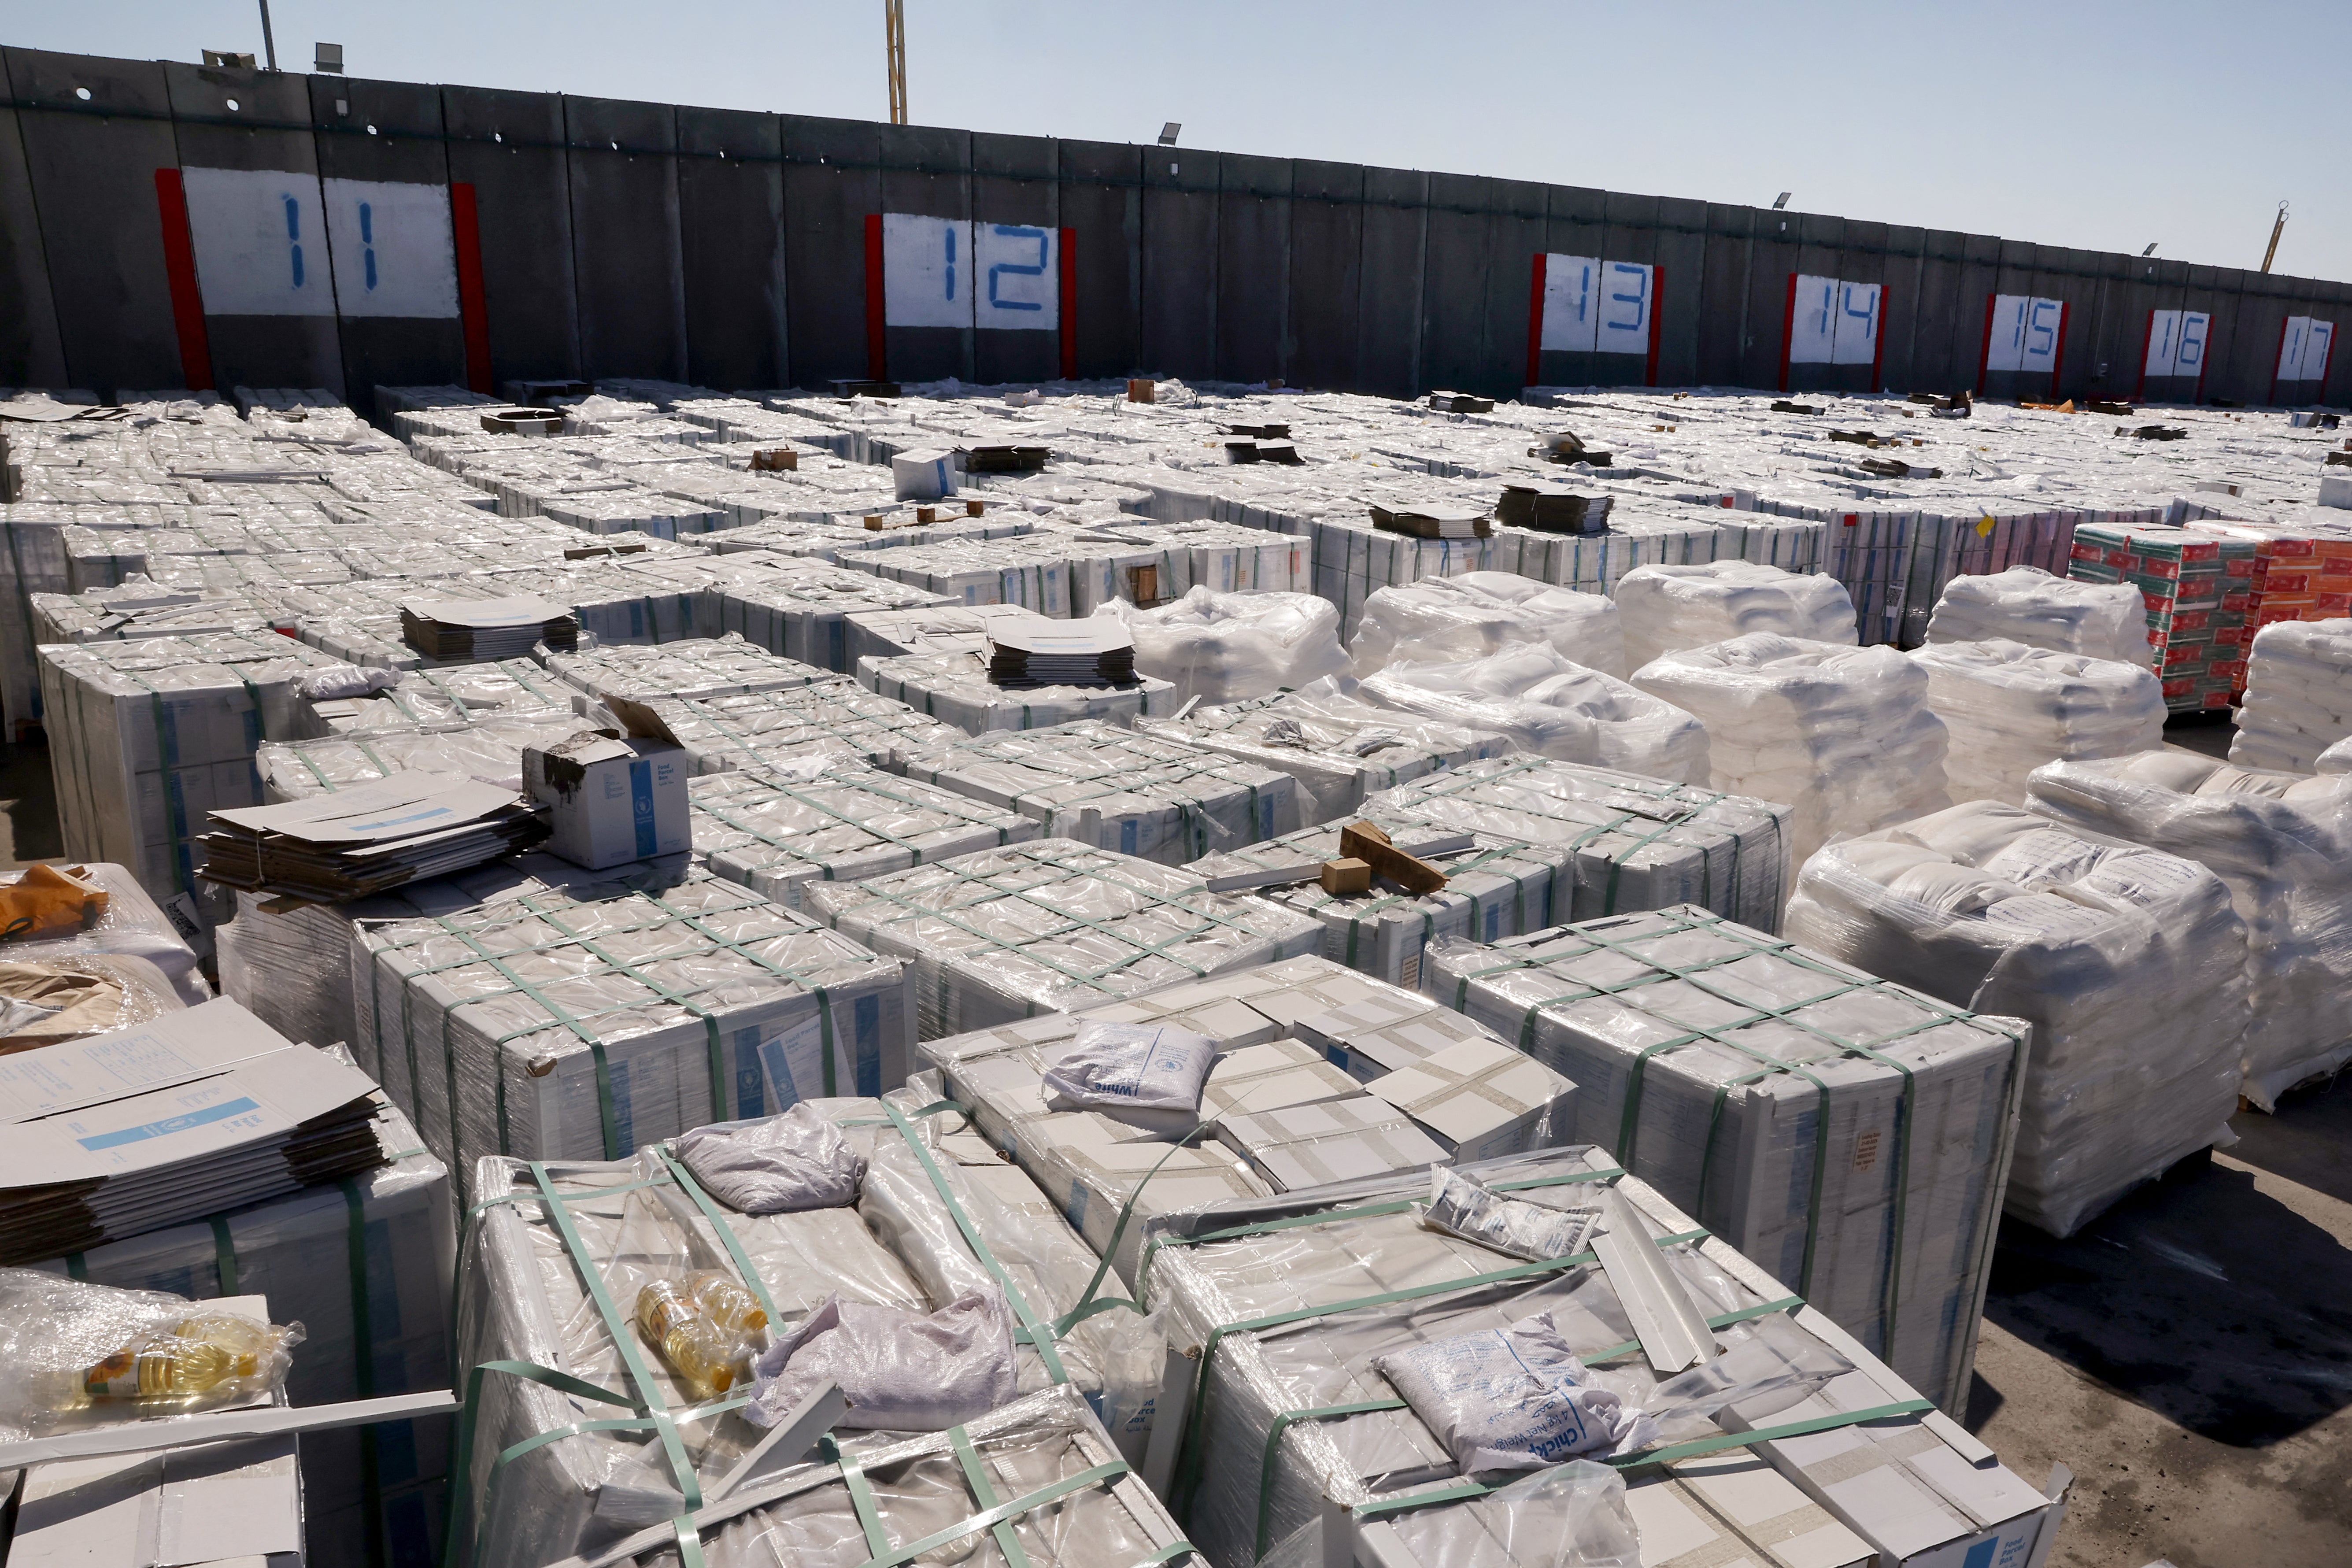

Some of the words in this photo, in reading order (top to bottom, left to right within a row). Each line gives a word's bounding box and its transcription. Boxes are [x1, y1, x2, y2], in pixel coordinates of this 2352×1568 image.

[281, 192, 378, 294] 11
[945, 225, 1049, 311] 12
[1579, 264, 1646, 331] 13
[1820, 285, 1876, 339] 14
[2013, 303, 2056, 355] 15
[2162, 317, 2204, 364] 16
[2290, 327, 2329, 368] 17
[785, 1033, 800, 1044] Food
[801, 1023, 820, 1036] Parcel
[1095, 1083, 1131, 1096] White
[1532, 1396, 1559, 1418] حمص
[1561, 1410, 1568, 1420] 4
[1526, 1423, 1548, 1438] Net
[1545, 1414, 1562, 1427] kg
[2001, 1542, 2026, 1557] Parcel
[2004, 1536, 2023, 1549] Food
[1999, 1556, 2013, 1565] Box
